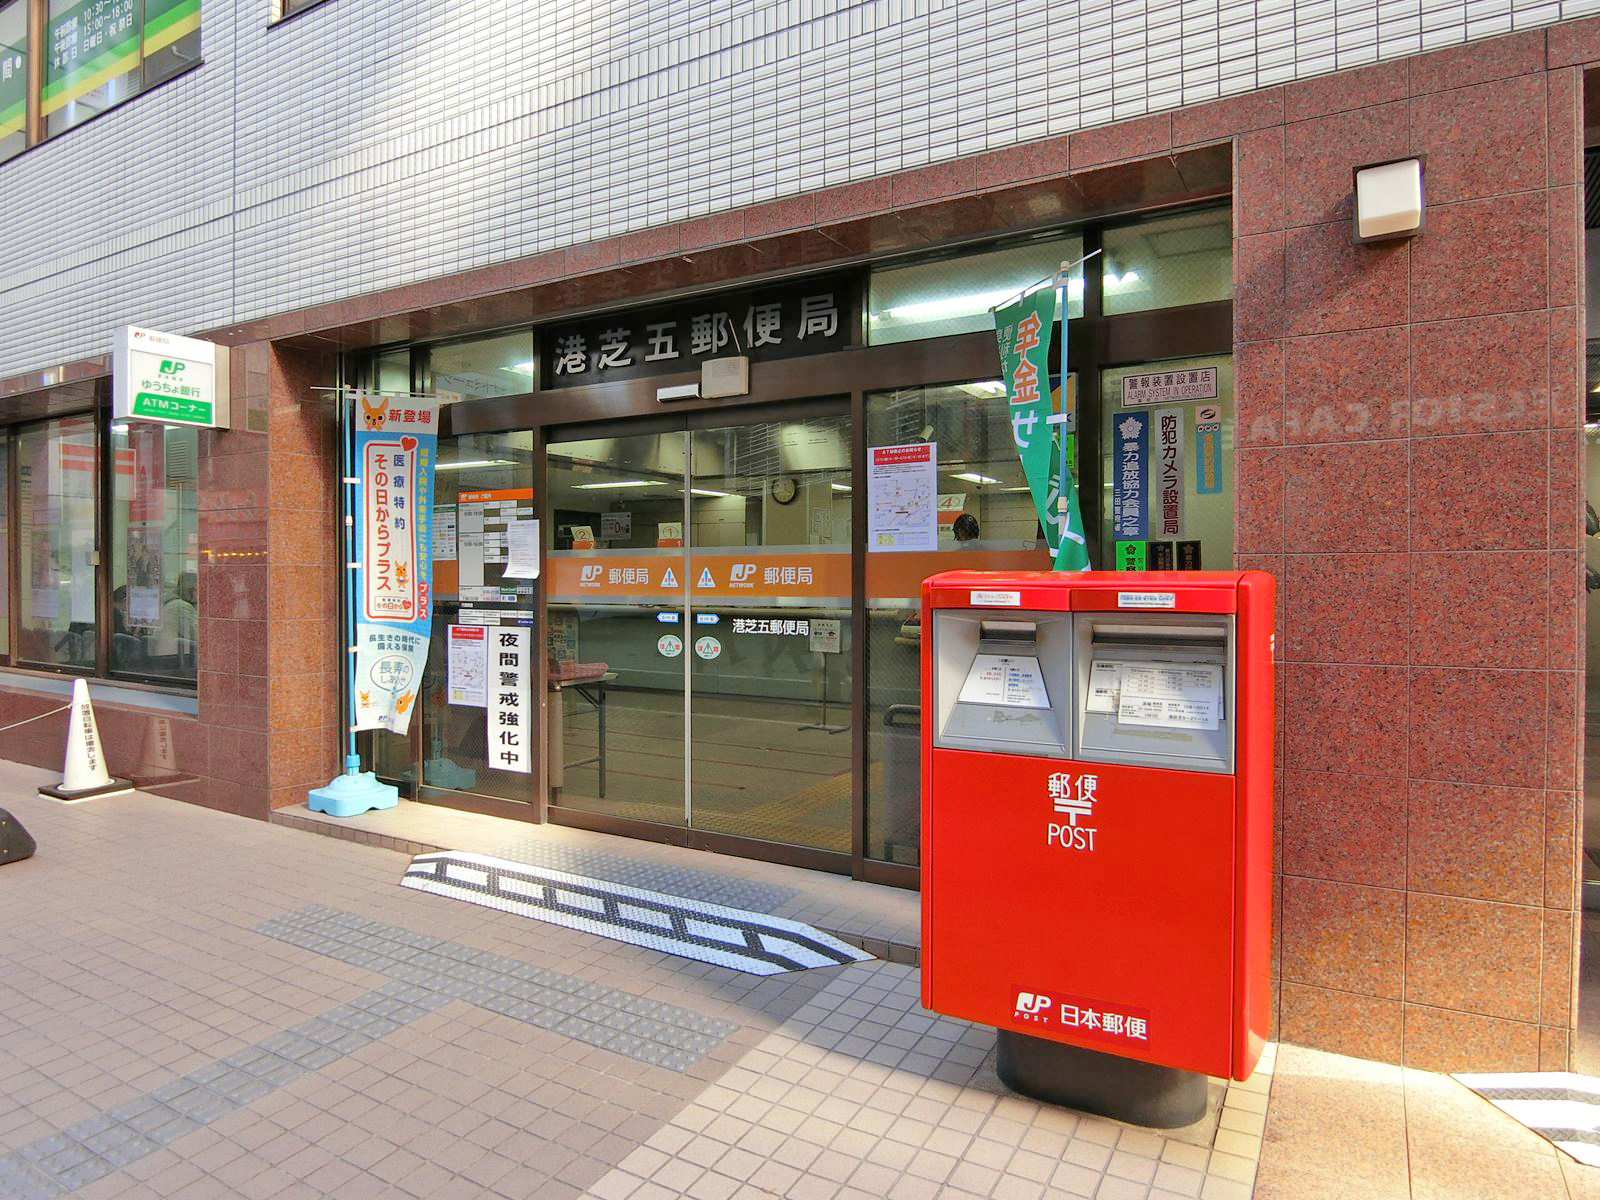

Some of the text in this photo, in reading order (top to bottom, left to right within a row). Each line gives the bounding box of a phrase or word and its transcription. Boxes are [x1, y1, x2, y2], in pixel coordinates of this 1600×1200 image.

[555, 293, 839, 376] 港芝五郵便局
[160, 359, 186, 375] JP
[142, 379, 201, 398] ゆうちょ銀行
[1128, 370, 1211, 390] 警報装置設置店
[1127, 389, 1146, 400] ALARM
[1148, 387, 1171, 398] SYSTEM
[1181, 383, 1212, 396] OPERATION
[143, 397, 206, 412] ATMコーナー
[388, 408, 432, 424] 新登場
[1161, 415, 1179, 535] 防犯カメラ設置局
[393, 454, 405, 530] 医療特約
[374, 454, 391, 591] その日からプラス
[580, 565, 649, 585] JP 郵便局
[730, 563, 813, 585] JP 郵便局
[418, 583, 428, 619] プラス
[732, 618, 810, 636] 港芝五郵便局
[368, 634, 421, 645] 長生きの時代に
[498, 632, 520, 766] 夜間警戒強化中
[1047, 772, 1098, 802] 郵便
[1047, 823, 1098, 852] POST
[1014, 1011, 1049, 1024] POST
[1015, 992, 1148, 1041] JP 日本郵便
